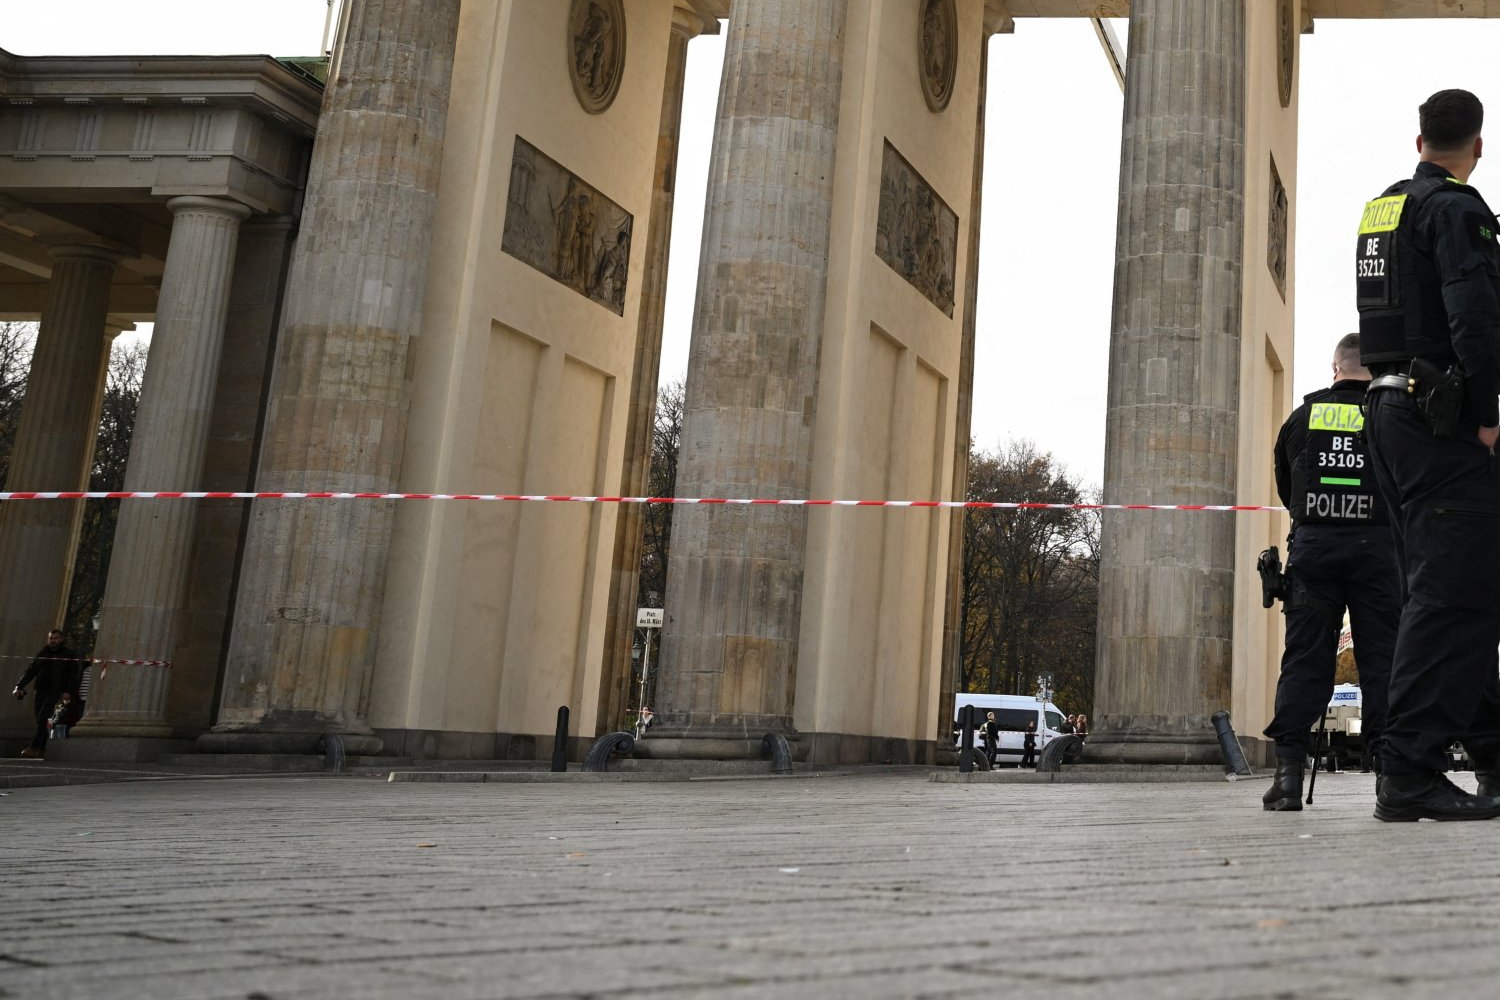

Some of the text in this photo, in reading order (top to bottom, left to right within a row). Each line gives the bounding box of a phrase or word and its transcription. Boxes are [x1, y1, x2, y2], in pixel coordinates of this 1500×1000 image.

[1366, 237, 1380, 256] BE
[1358, 258, 1385, 277] 35212
[1332, 436, 1353, 451] BE
[1318, 452, 1365, 473] 35105
